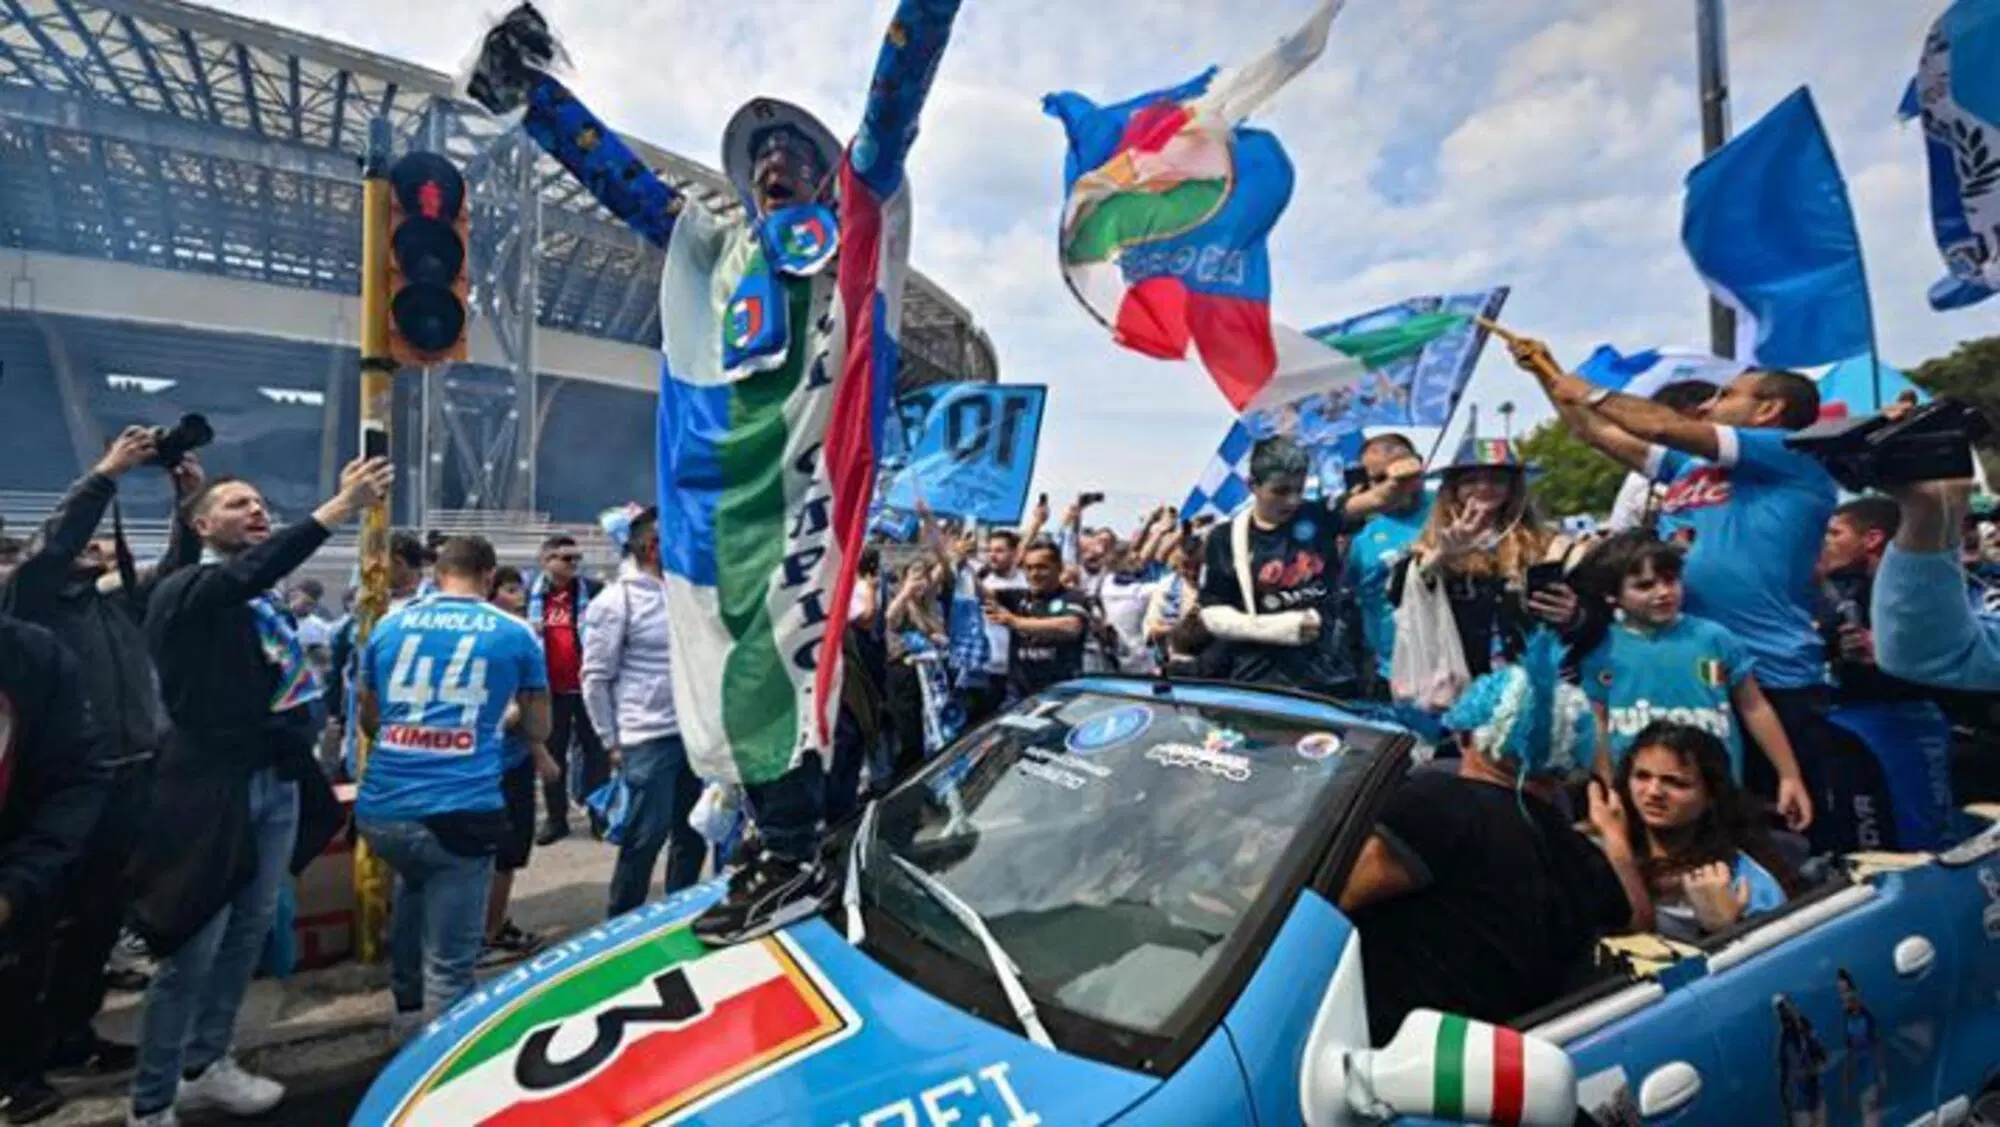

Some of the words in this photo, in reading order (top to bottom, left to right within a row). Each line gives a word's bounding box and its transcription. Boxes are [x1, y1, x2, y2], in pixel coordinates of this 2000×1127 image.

[400, 610, 498, 632] MANOLAS
[386, 632, 489, 729] 44
[1607, 698, 1730, 739] uioni
[384, 725, 474, 750] KIMBO
